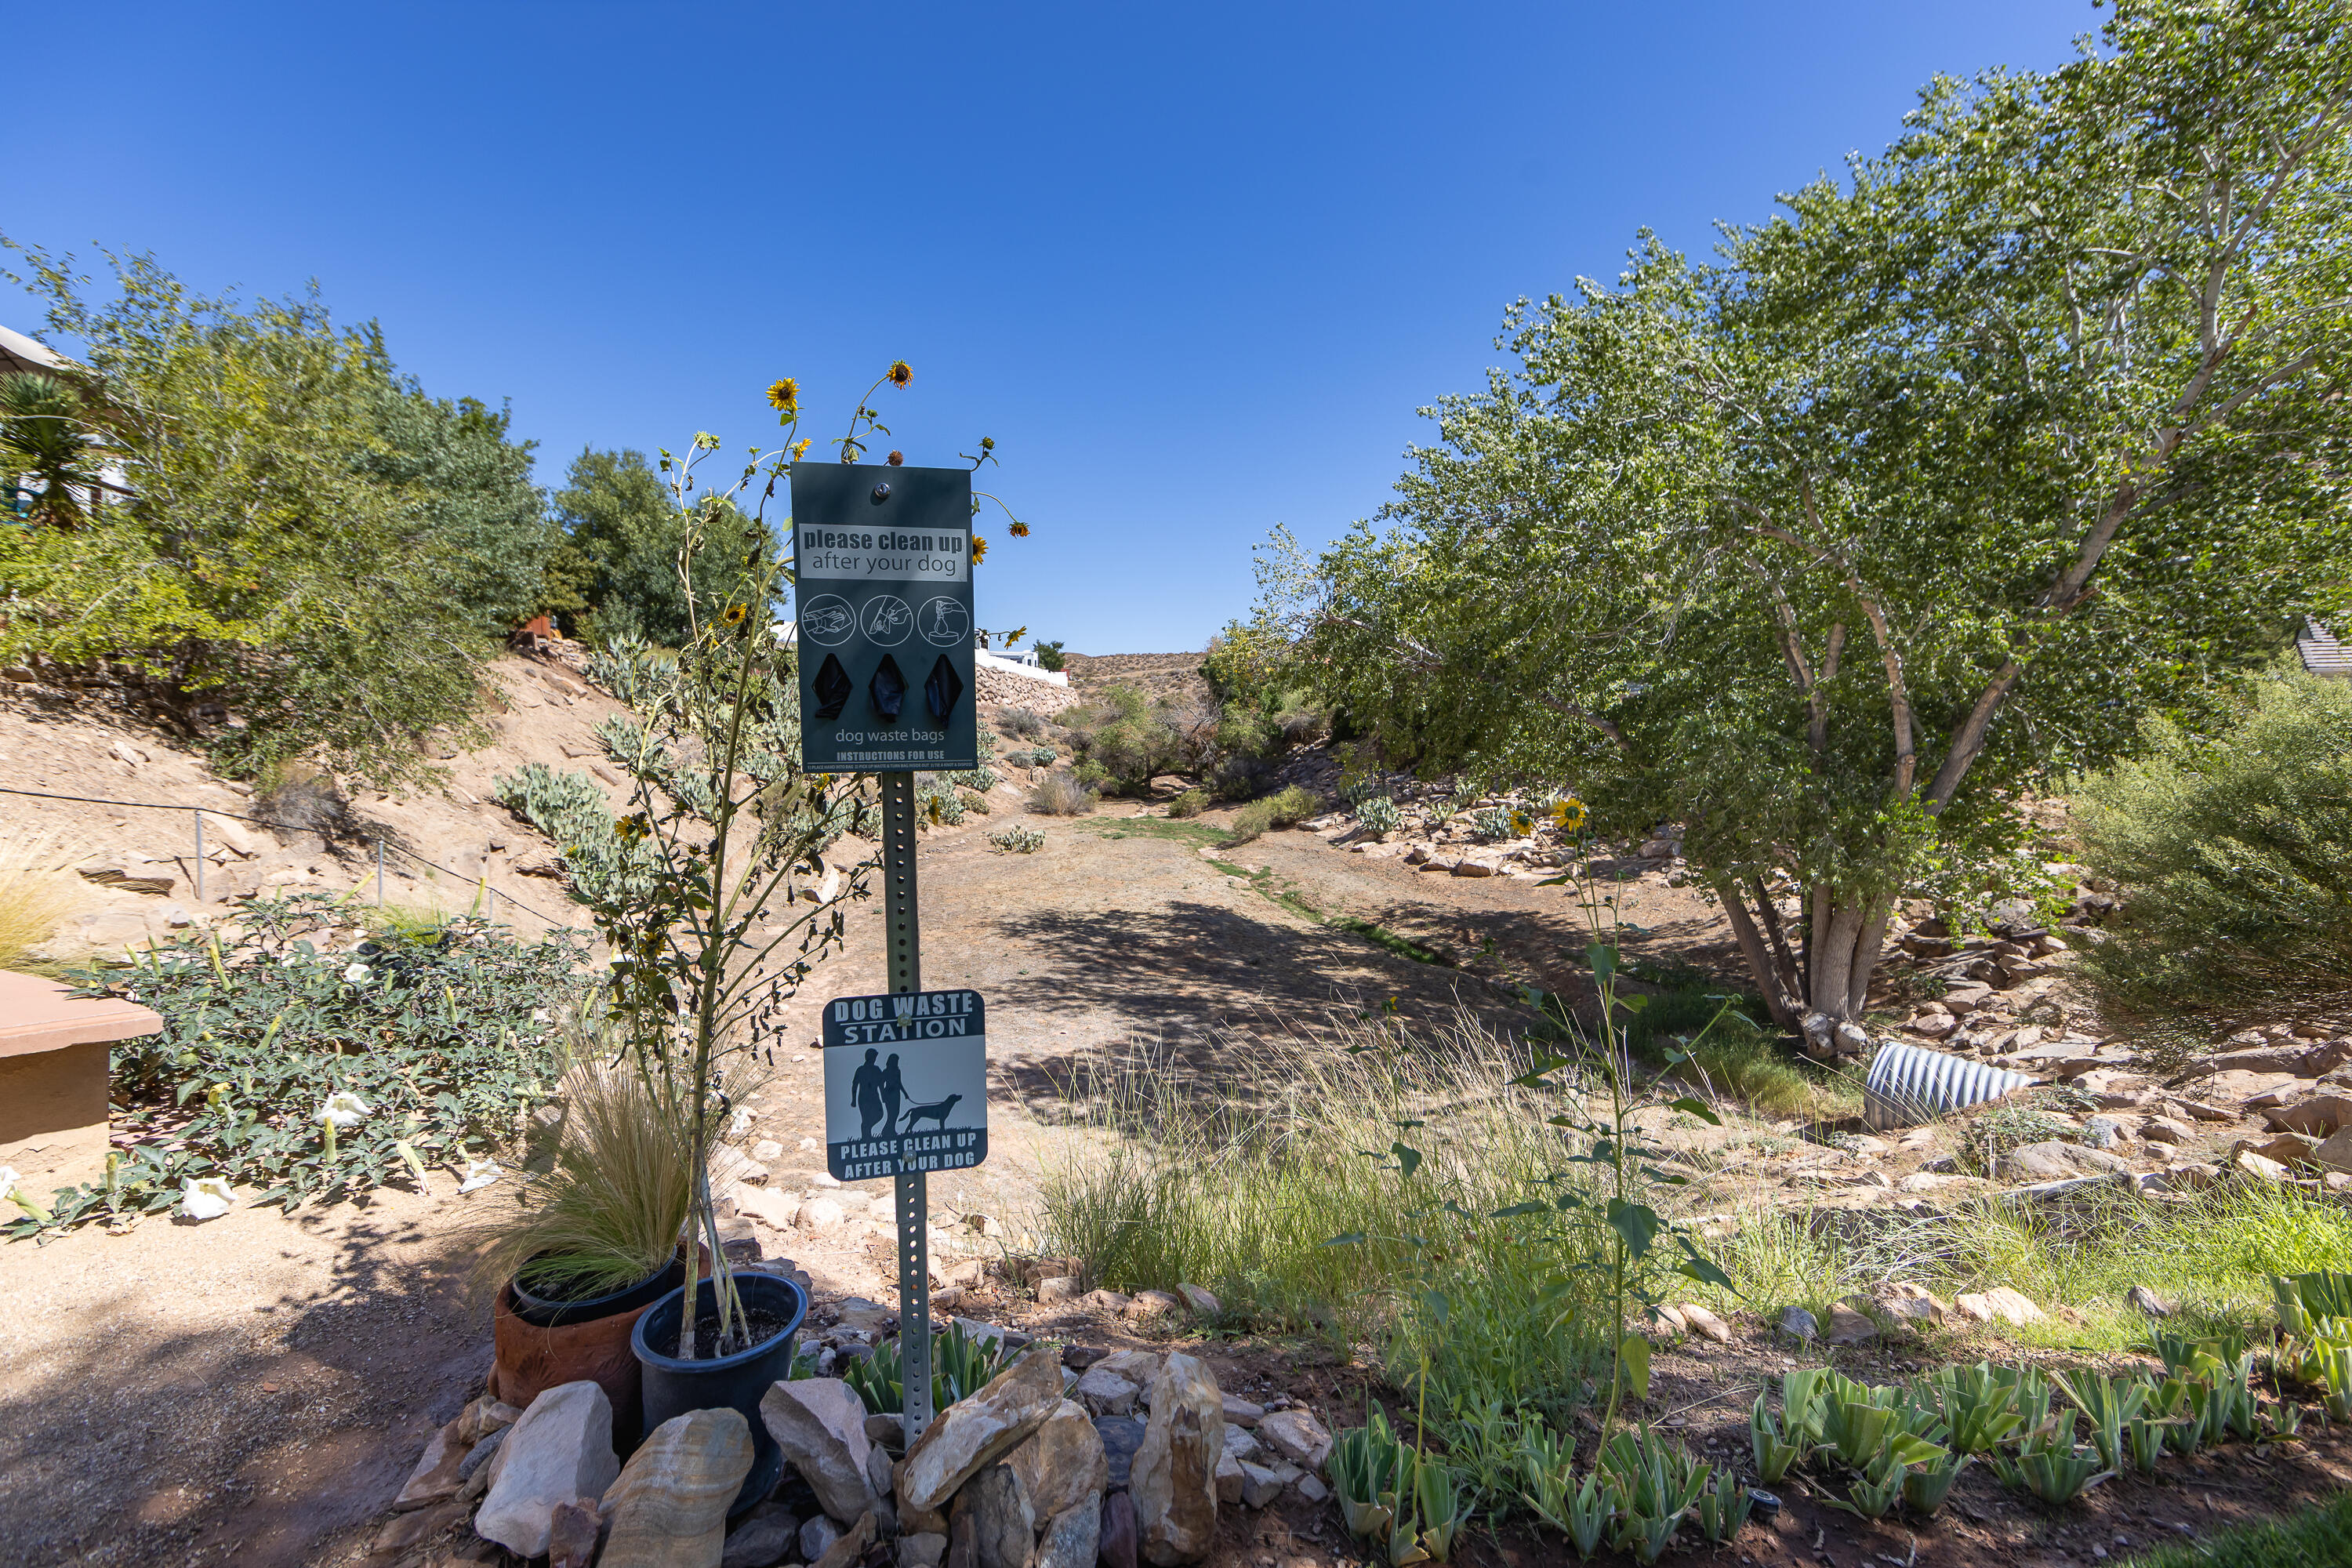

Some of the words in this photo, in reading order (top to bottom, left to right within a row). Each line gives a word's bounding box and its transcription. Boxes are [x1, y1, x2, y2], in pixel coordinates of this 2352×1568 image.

[804, 529, 873, 550] please
[878, 532, 933, 551] clean
[938, 535, 963, 554] up
[812, 551, 860, 569] after
[866, 557, 912, 575] your
[917, 554, 956, 576] dog
[835, 728, 863, 745] dog
[867, 730, 908, 742] waste
[912, 728, 945, 744] bags
[837, 750, 906, 761] INSTRUCTIONS
[908, 750, 925, 760] FOR
[927, 750, 945, 760] USE
[835, 998, 884, 1022] DOG
[893, 993, 973, 1018] WASTE
[844, 1018, 965, 1044] STATION
[840, 1140, 898, 1160] PLEASE
[904, 1135, 951, 1152] CLEAN
[956, 1132, 976, 1147] UP
[844, 1159, 891, 1178] AFTER
[944, 1152, 975, 1167] DOG
